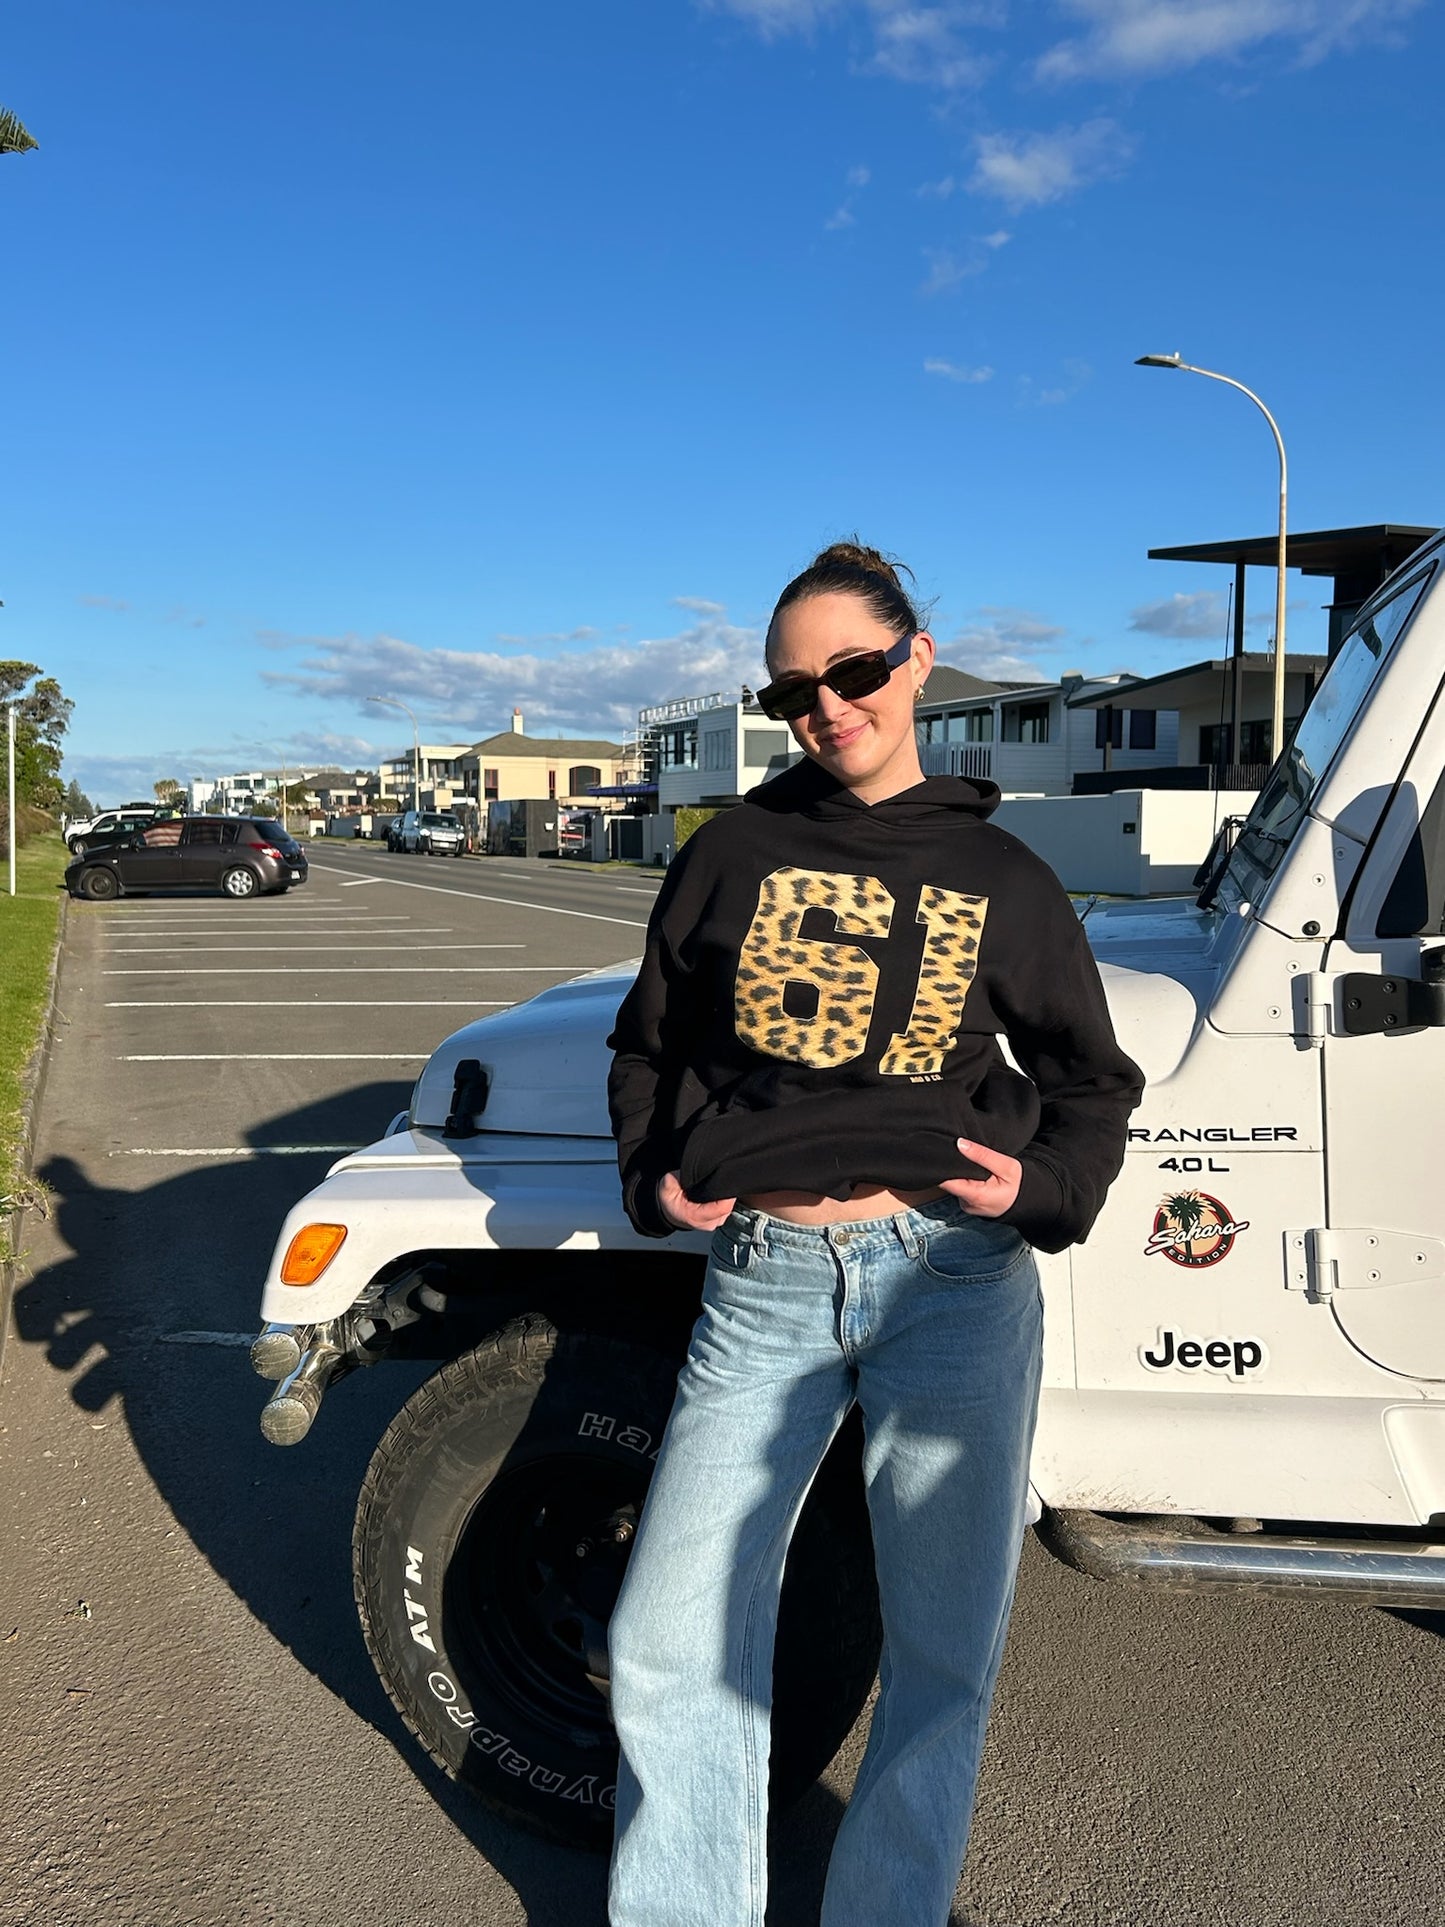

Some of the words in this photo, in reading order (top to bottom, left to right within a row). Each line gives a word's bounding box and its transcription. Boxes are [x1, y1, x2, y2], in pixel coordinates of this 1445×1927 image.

[735, 866, 989, 1075] 61
[1144, 1220, 1250, 1256] Sahara
[1168, 1244, 1228, 1264] EDITION
[1145, 1331, 1262, 1376] Jeep
[578, 1412, 661, 1461] Ha
